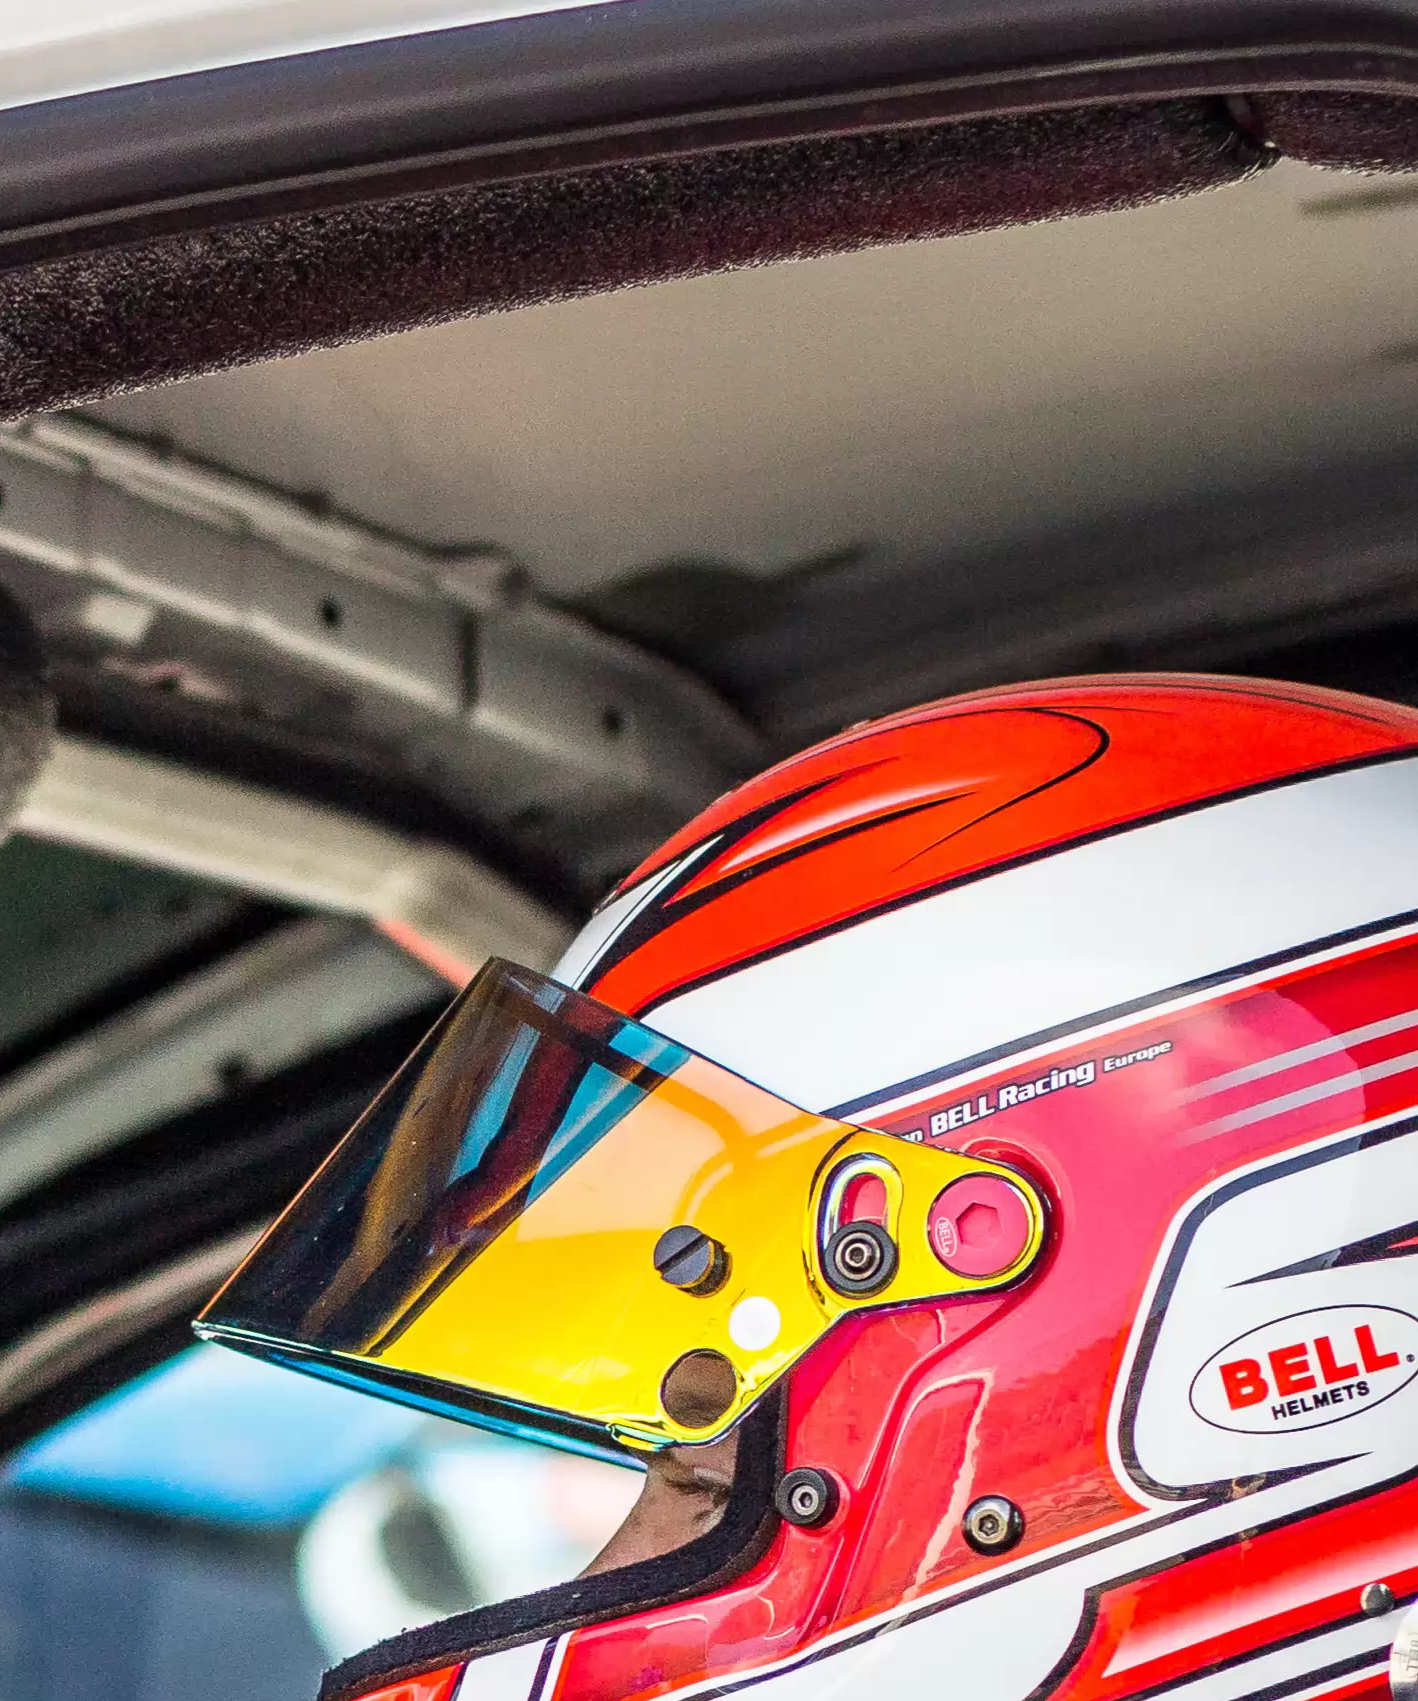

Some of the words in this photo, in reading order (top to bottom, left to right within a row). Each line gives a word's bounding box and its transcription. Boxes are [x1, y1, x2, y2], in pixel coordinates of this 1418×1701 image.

[930, 1095, 995, 1137] BELL
[998, 1060, 1095, 1110] Racing
[1103, 1040, 1173, 1073] Europe
[938, 1220, 952, 1250] BELL
[1219, 1323, 1401, 1411] BELL
[1271, 1381, 1370, 1420] HELMETS
